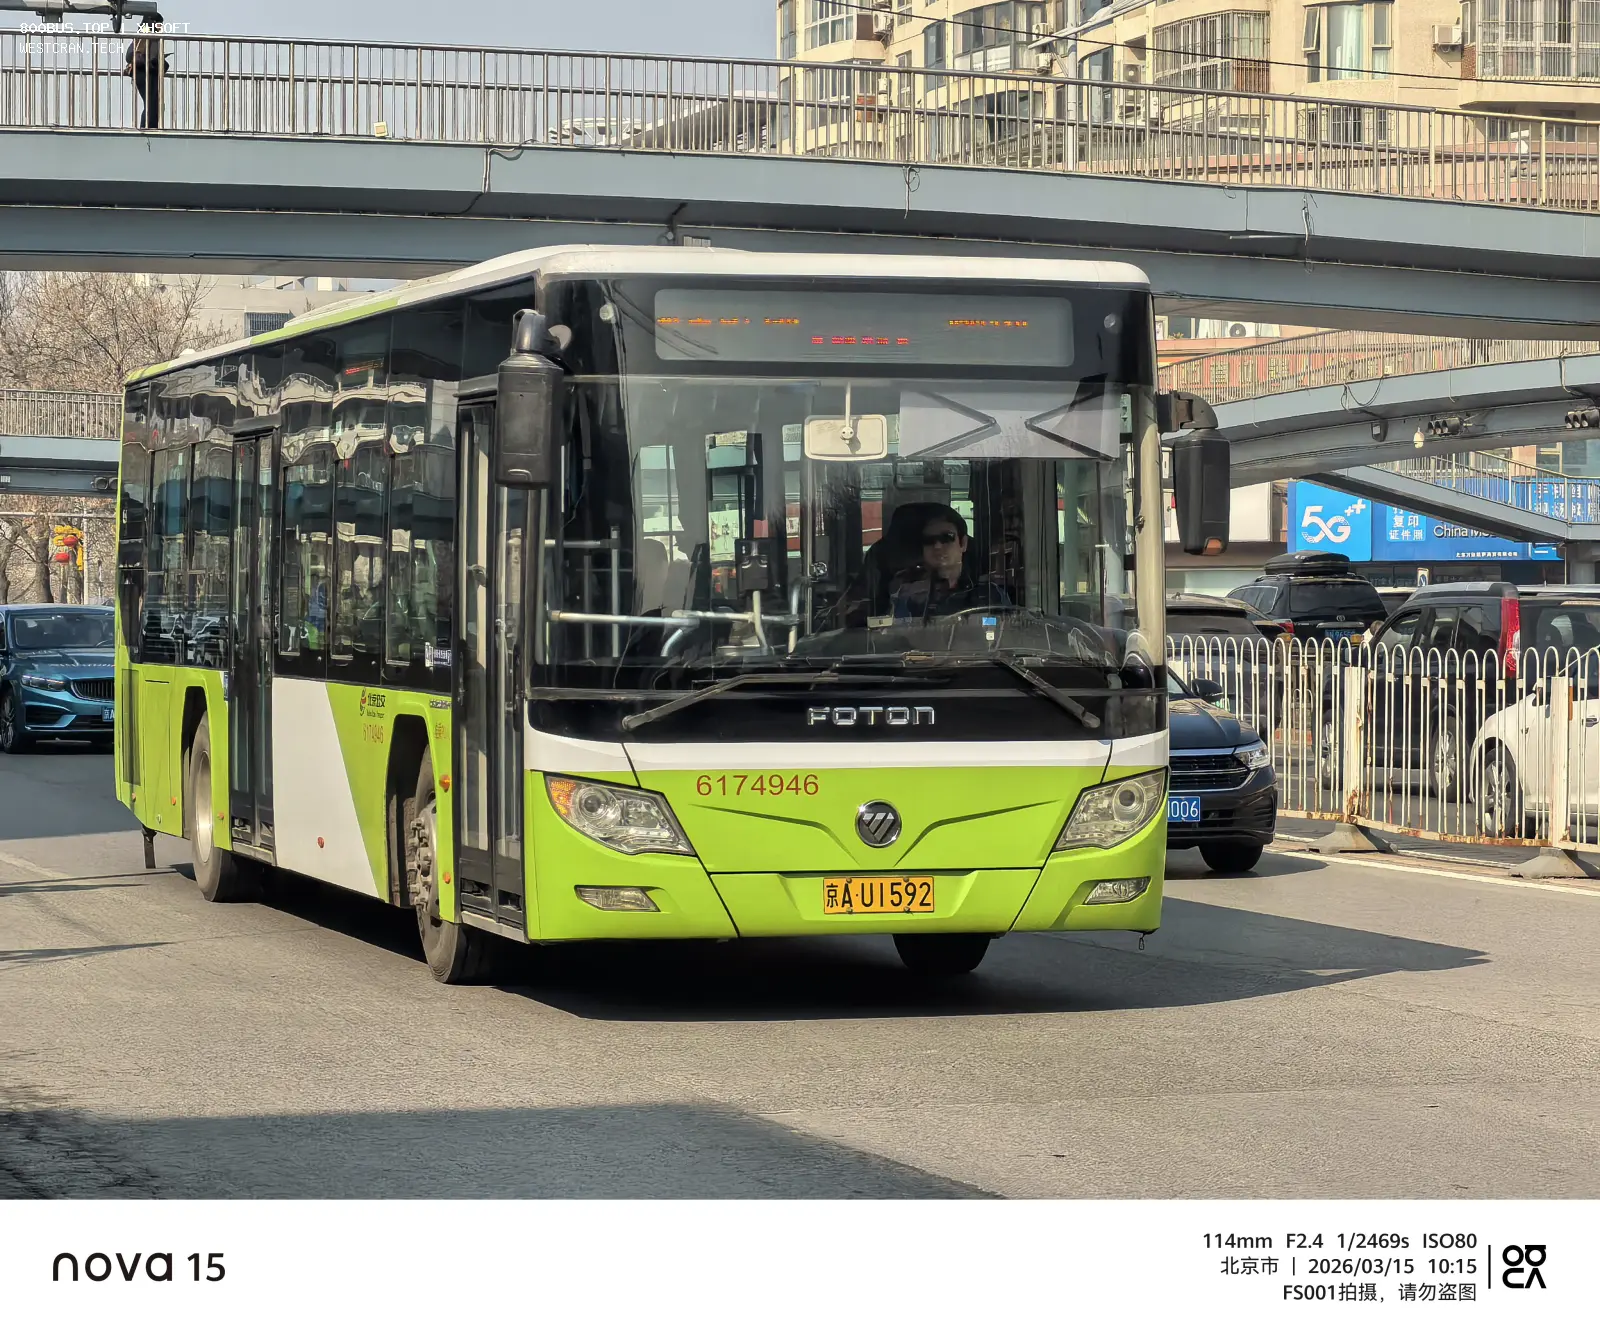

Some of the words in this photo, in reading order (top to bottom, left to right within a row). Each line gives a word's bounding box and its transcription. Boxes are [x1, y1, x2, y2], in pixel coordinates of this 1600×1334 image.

[1393, 515, 1419, 528] 复印
[1389, 530, 1423, 541] 证件照
[1433, 524, 1468, 537] China
[806, 706, 936, 726] FOTON
[696, 774, 820, 796] 6174946
